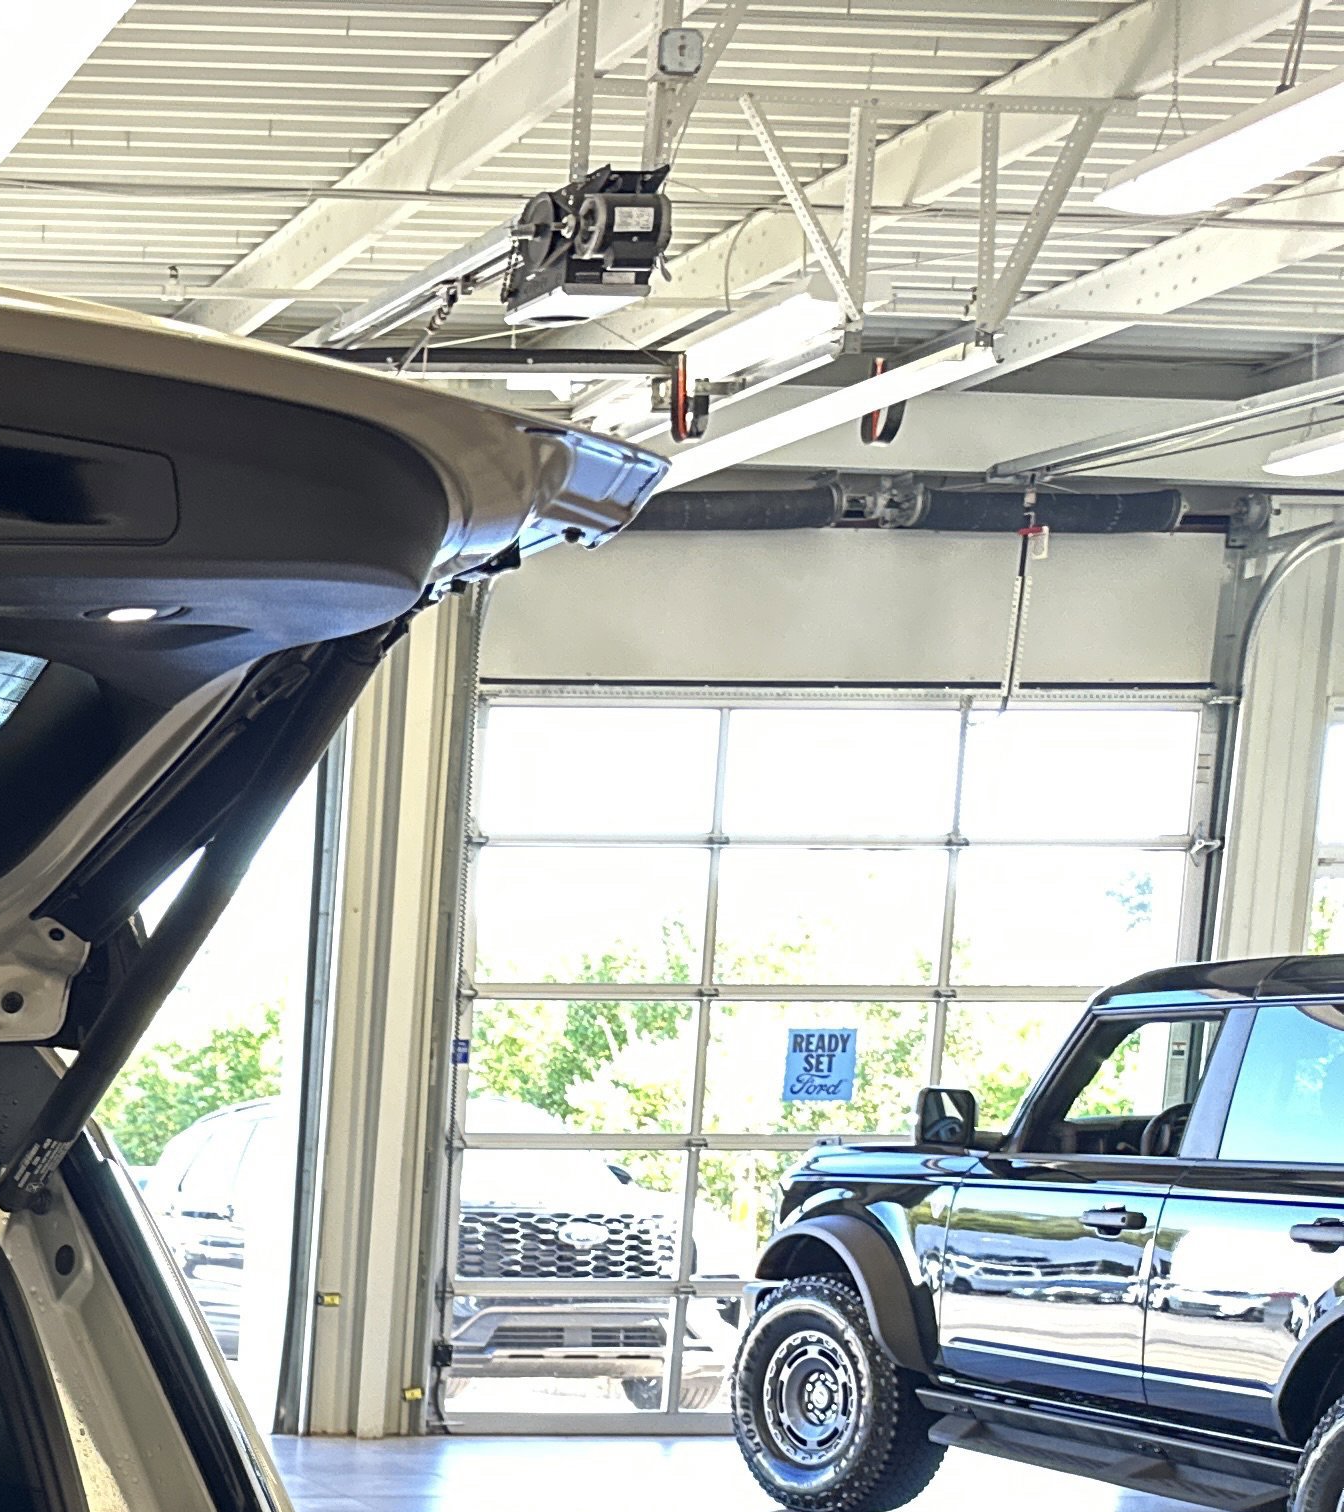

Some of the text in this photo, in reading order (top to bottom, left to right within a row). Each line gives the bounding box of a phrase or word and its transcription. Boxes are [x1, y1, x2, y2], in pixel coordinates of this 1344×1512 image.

[792, 1033, 851, 1053] READY
[802, 1053, 836, 1073] SET
[789, 1073, 844, 1096] Ford
